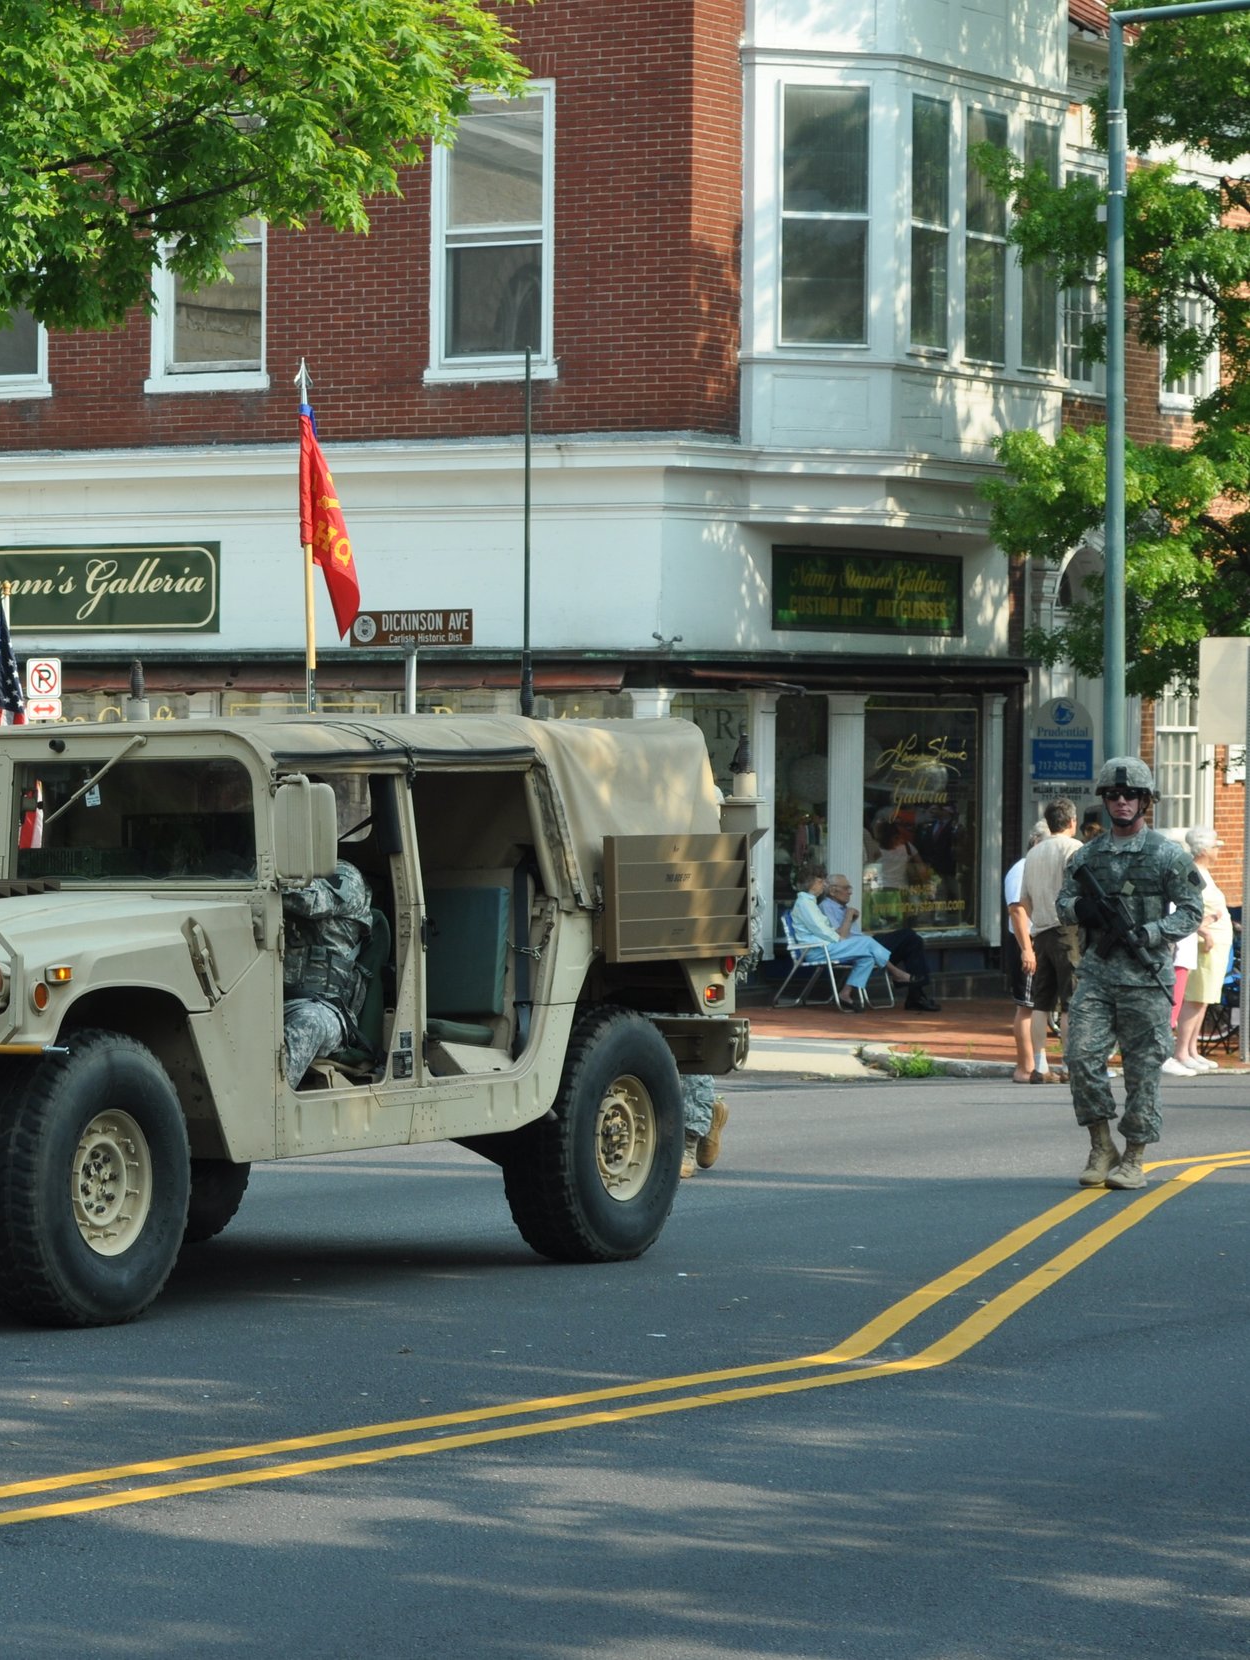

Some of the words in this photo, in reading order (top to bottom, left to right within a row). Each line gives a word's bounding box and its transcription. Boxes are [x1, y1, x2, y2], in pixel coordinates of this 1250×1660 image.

[313, 519, 352, 567] HQ
[76, 558, 206, 620] Galleria
[895, 566, 947, 600] Galleria
[790, 595, 838, 615] CUSTOM
[841, 598, 863, 617] ART
[876, 598, 897, 617] ART
[900, 601, 947, 619] CLASSES
[381, 612, 443, 632] DICKINSON
[448, 612, 470, 630] AVE
[389, 633, 415, 643] Carlisle
[417, 632, 445, 643] Historic
[448, 632, 463, 642] Dist
[1037, 725, 1088, 737] Prudential
[890, 777, 948, 824] Galleria
